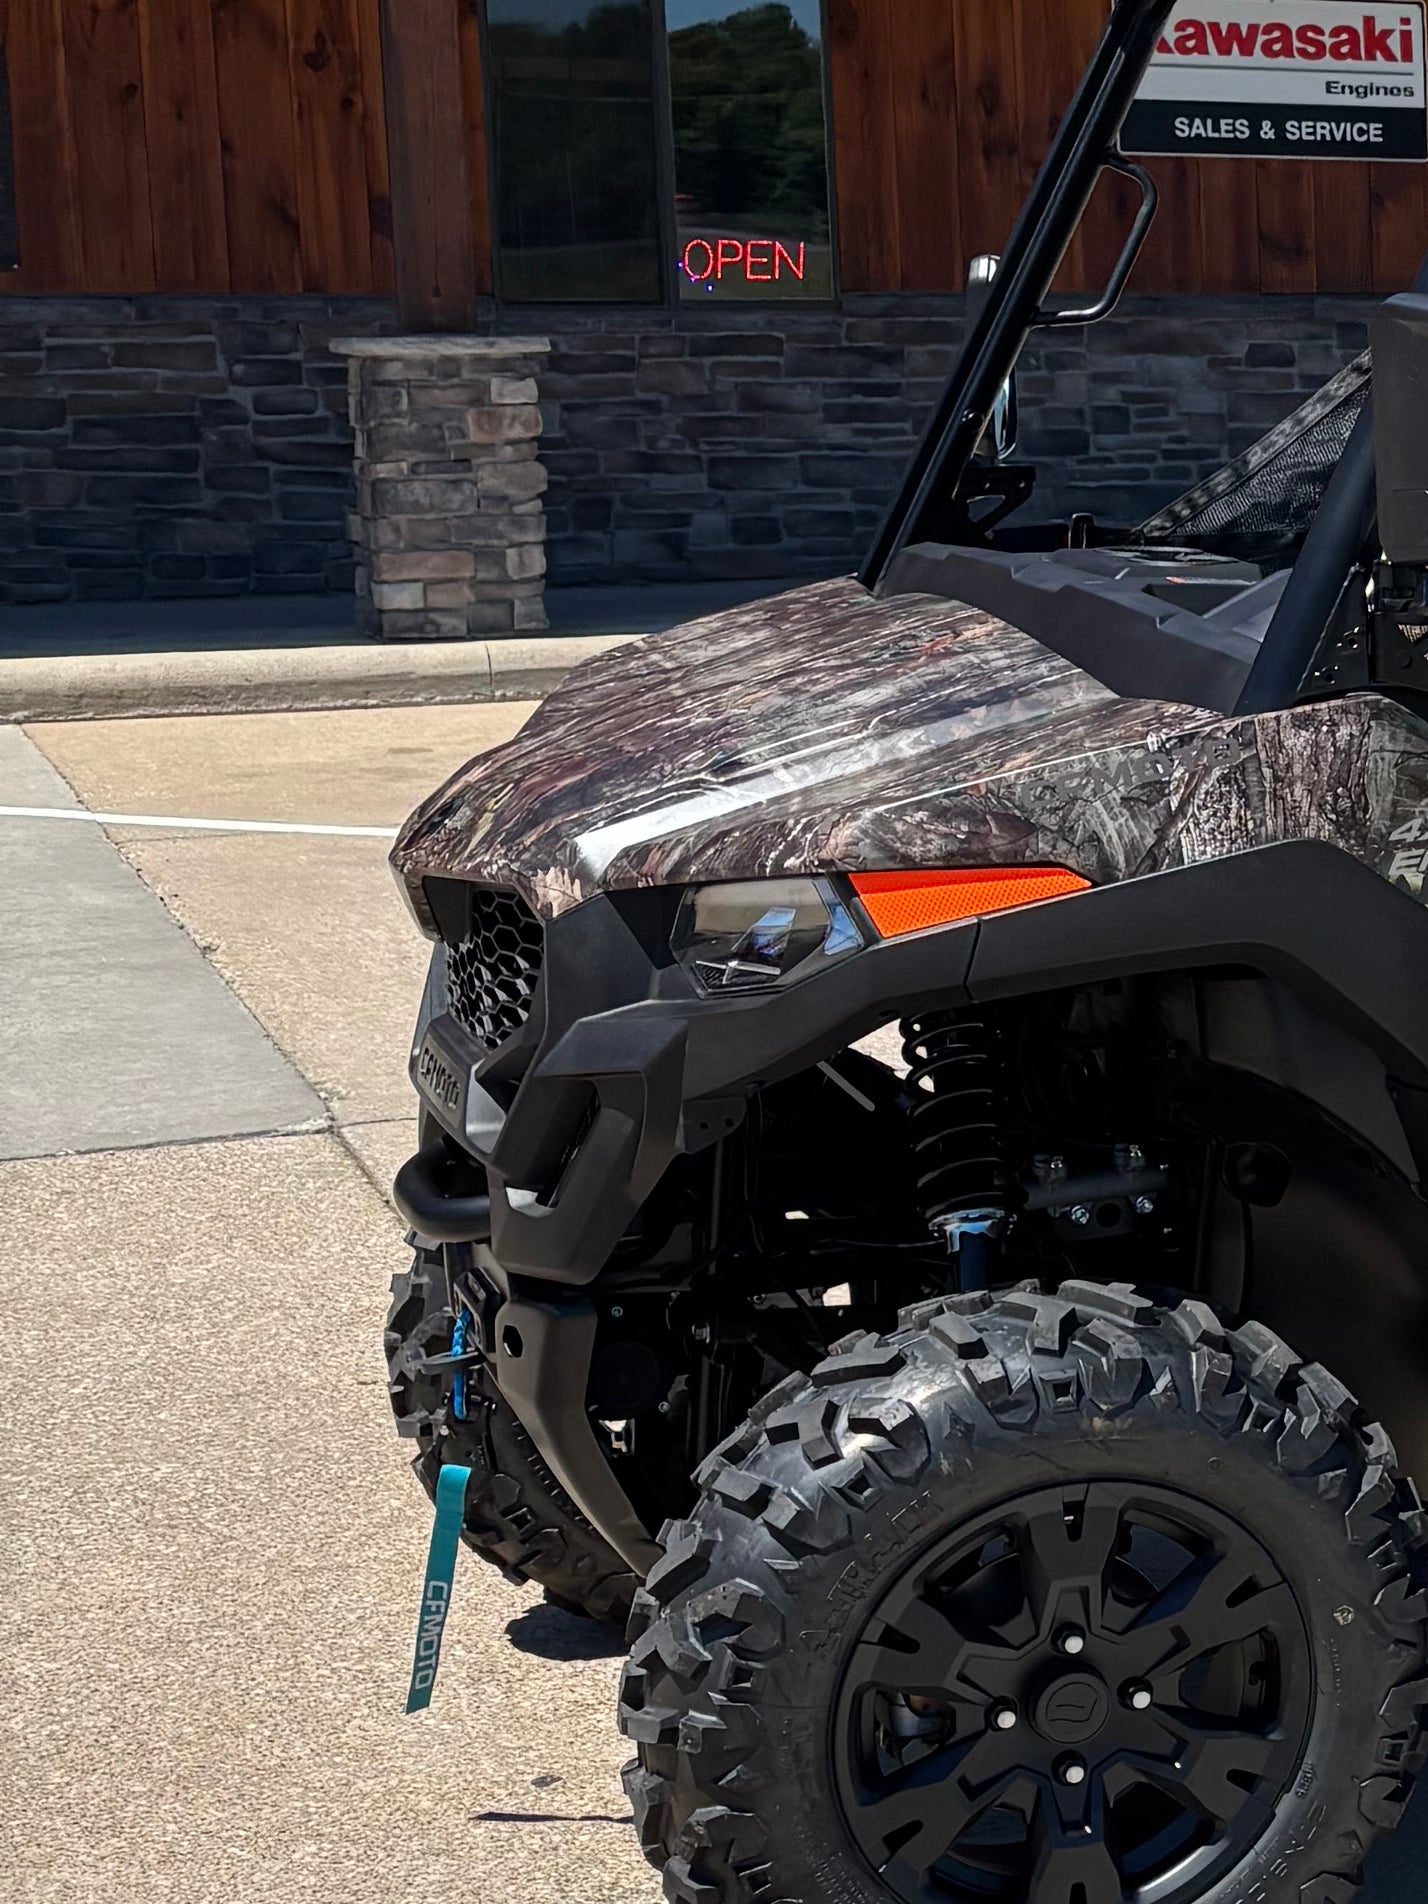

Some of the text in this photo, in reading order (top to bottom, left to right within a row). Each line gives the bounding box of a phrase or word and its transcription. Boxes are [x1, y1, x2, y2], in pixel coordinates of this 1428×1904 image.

[1325, 80, 1415, 99] Engines
[1174, 116, 1384, 143] SALES & SERVICE
[683, 238, 805, 281] OPEN
[415, 1579, 448, 1691] CFMOTO
